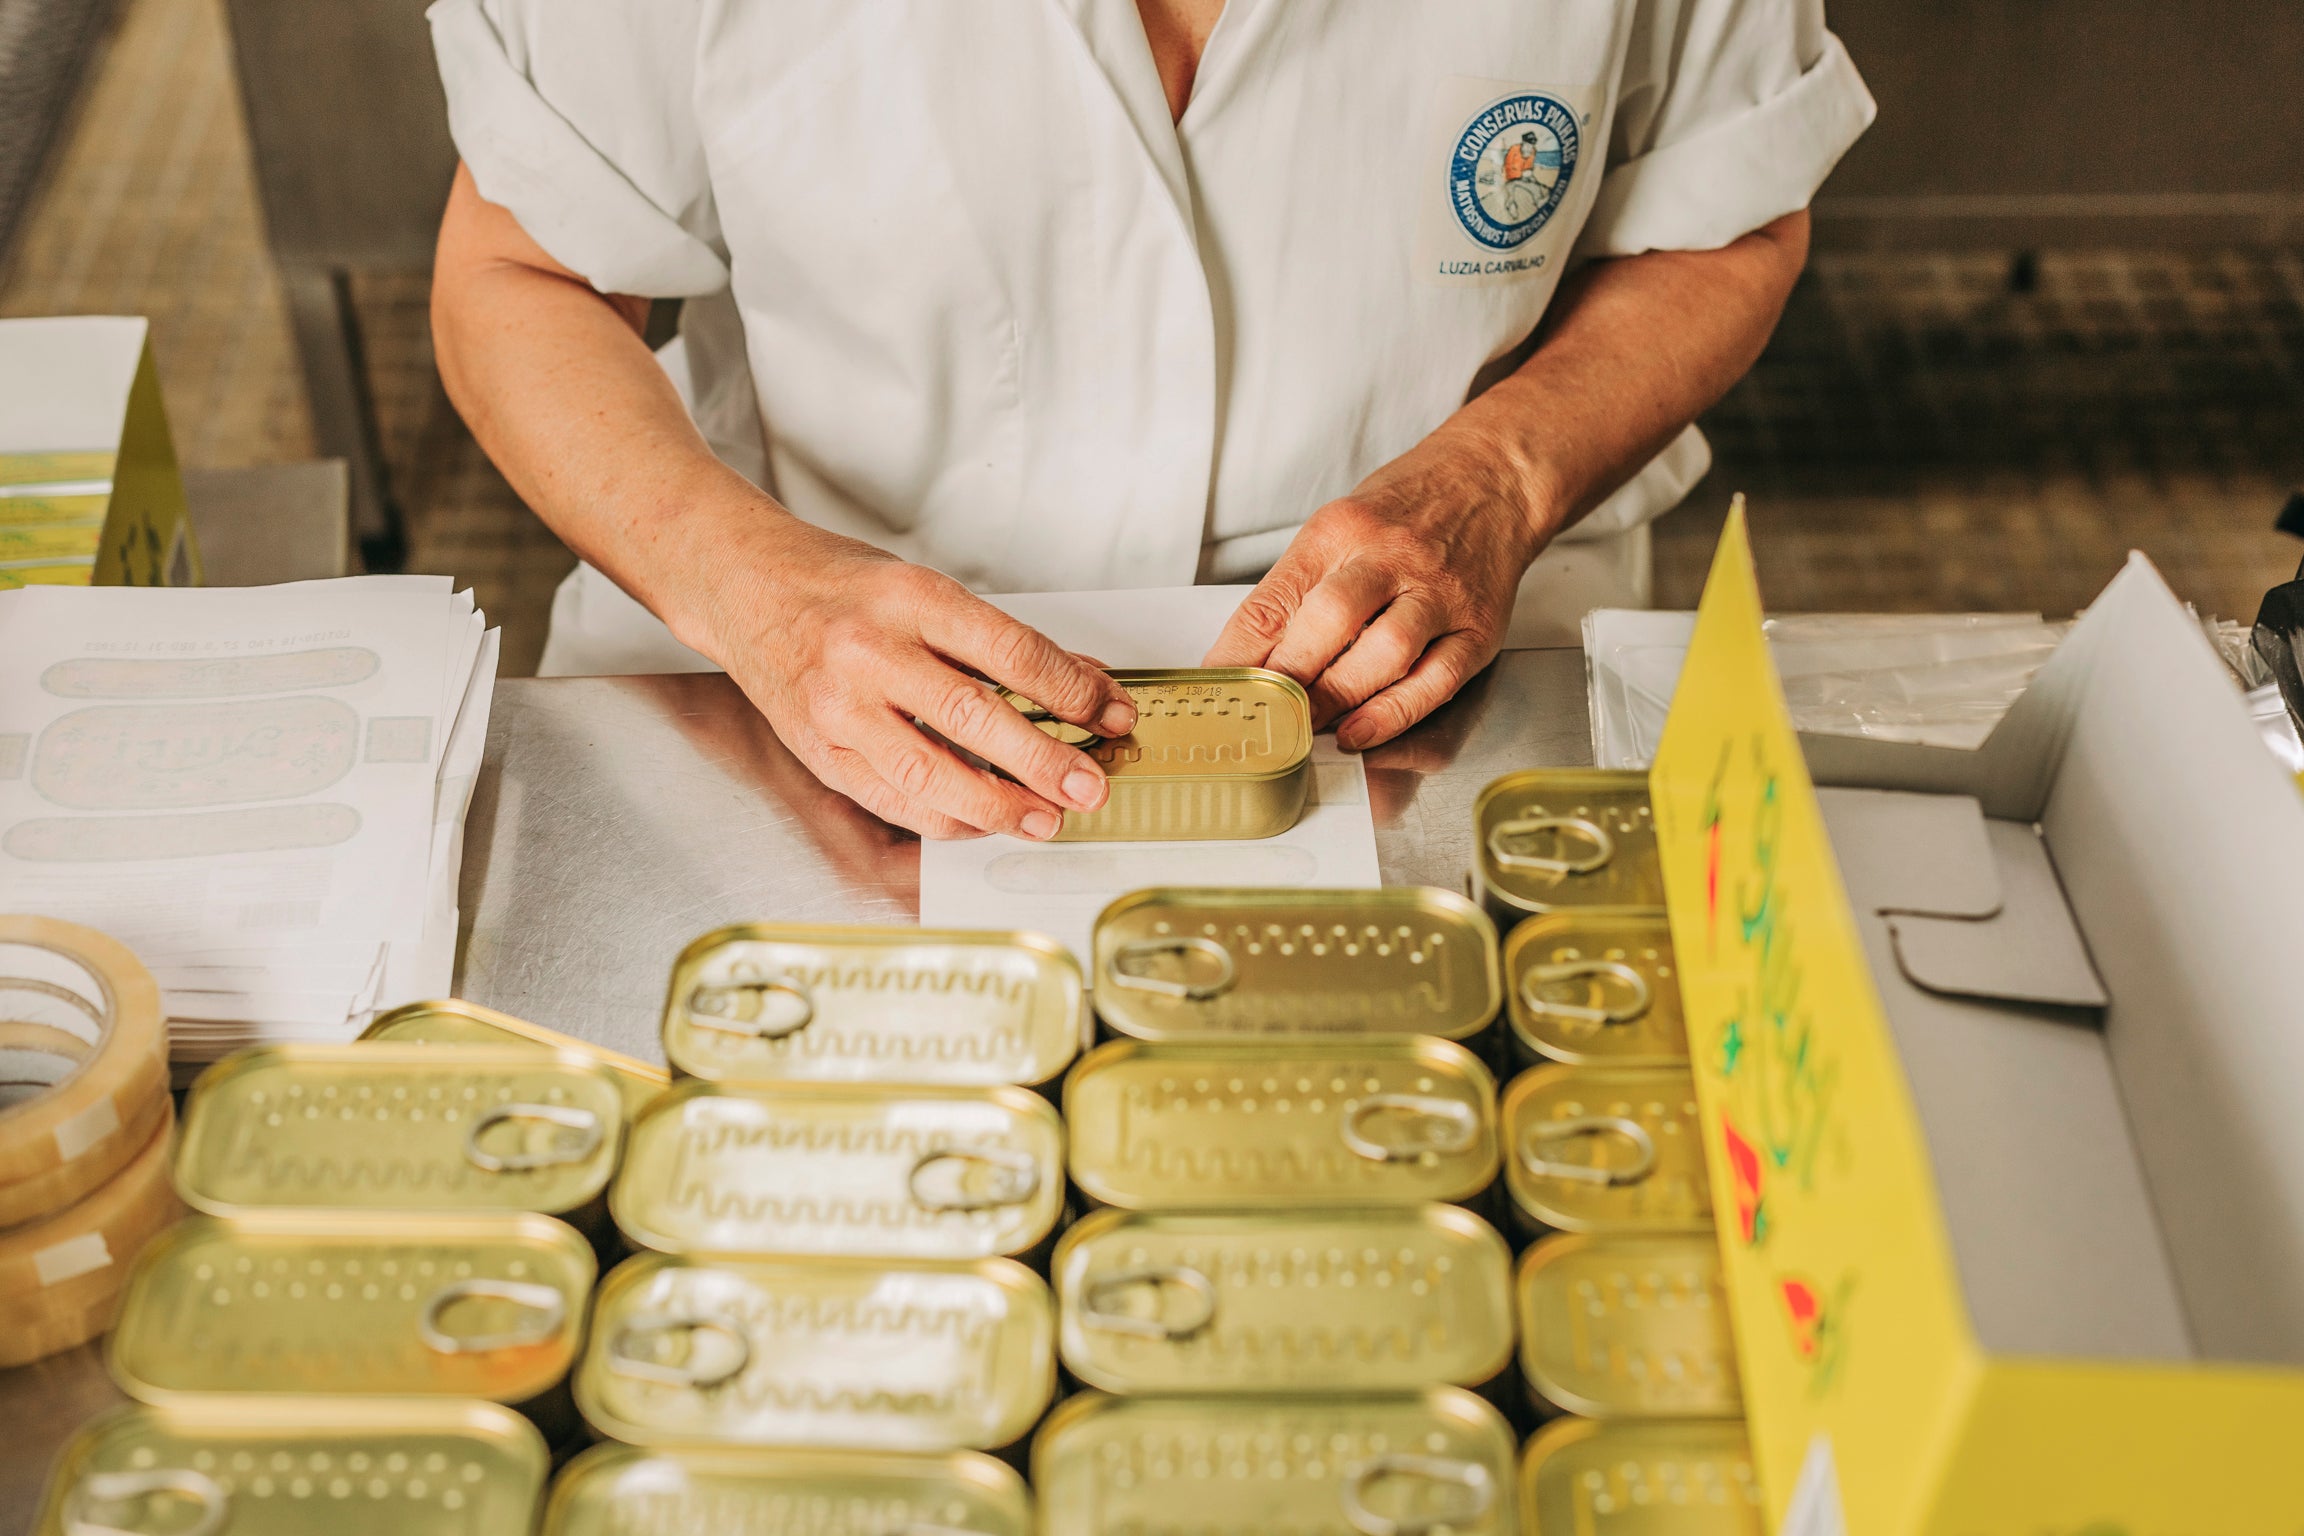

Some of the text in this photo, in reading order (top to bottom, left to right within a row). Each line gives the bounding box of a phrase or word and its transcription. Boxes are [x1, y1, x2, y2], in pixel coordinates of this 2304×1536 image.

[1459, 99, 1578, 165] CONSERVAS PINHAIS
[1439, 255, 1546, 275] LUZIA CARVALHO
[1185, 685, 1223, 697] 130/18
